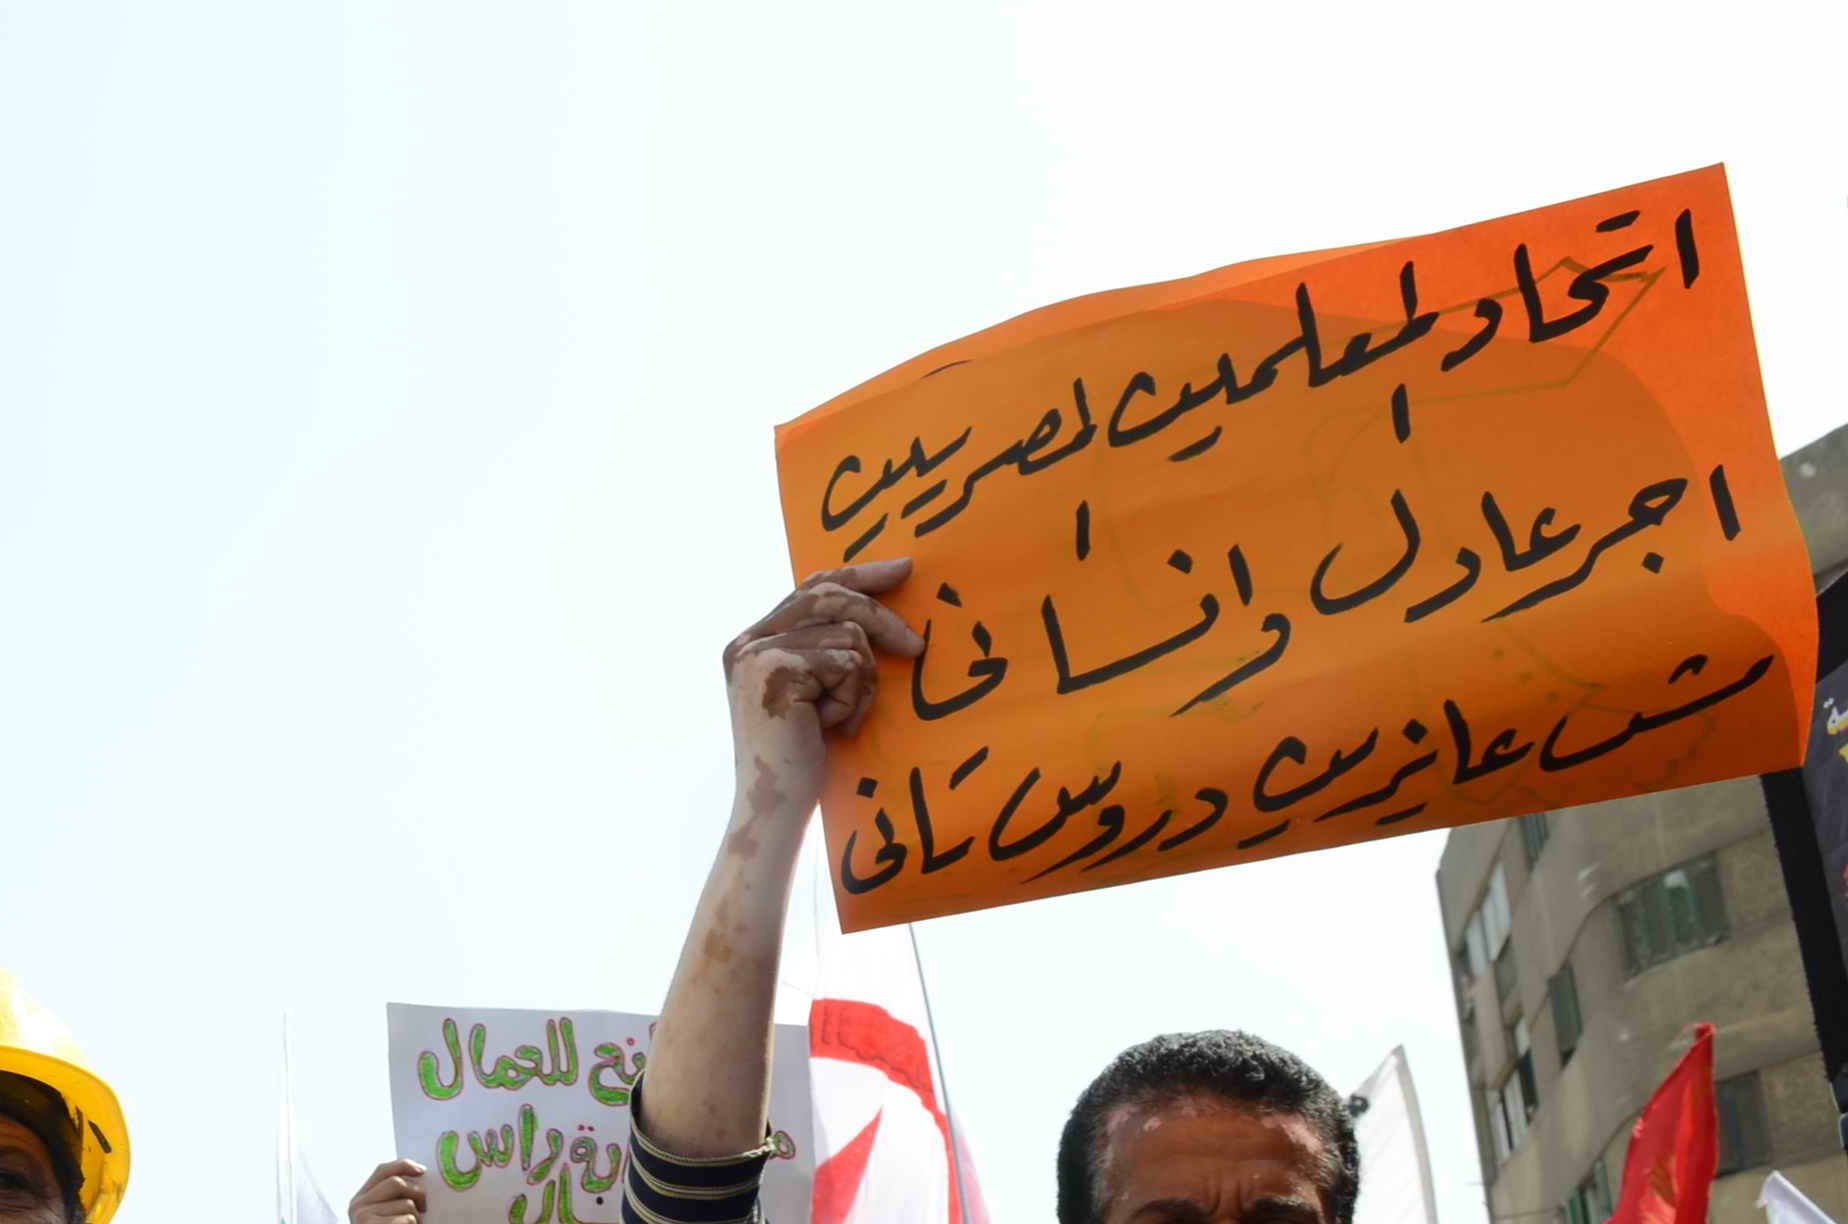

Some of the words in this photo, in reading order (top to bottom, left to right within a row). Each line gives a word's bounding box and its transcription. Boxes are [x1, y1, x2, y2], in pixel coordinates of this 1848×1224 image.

[1441, 208, 1698, 373] اتحاد
[1310, 489, 1581, 624] عادل
[1482, 465, 1742, 623] اجر
[987, 761, 1229, 883] دروس
[417, 1017, 579, 1101] للعمال
